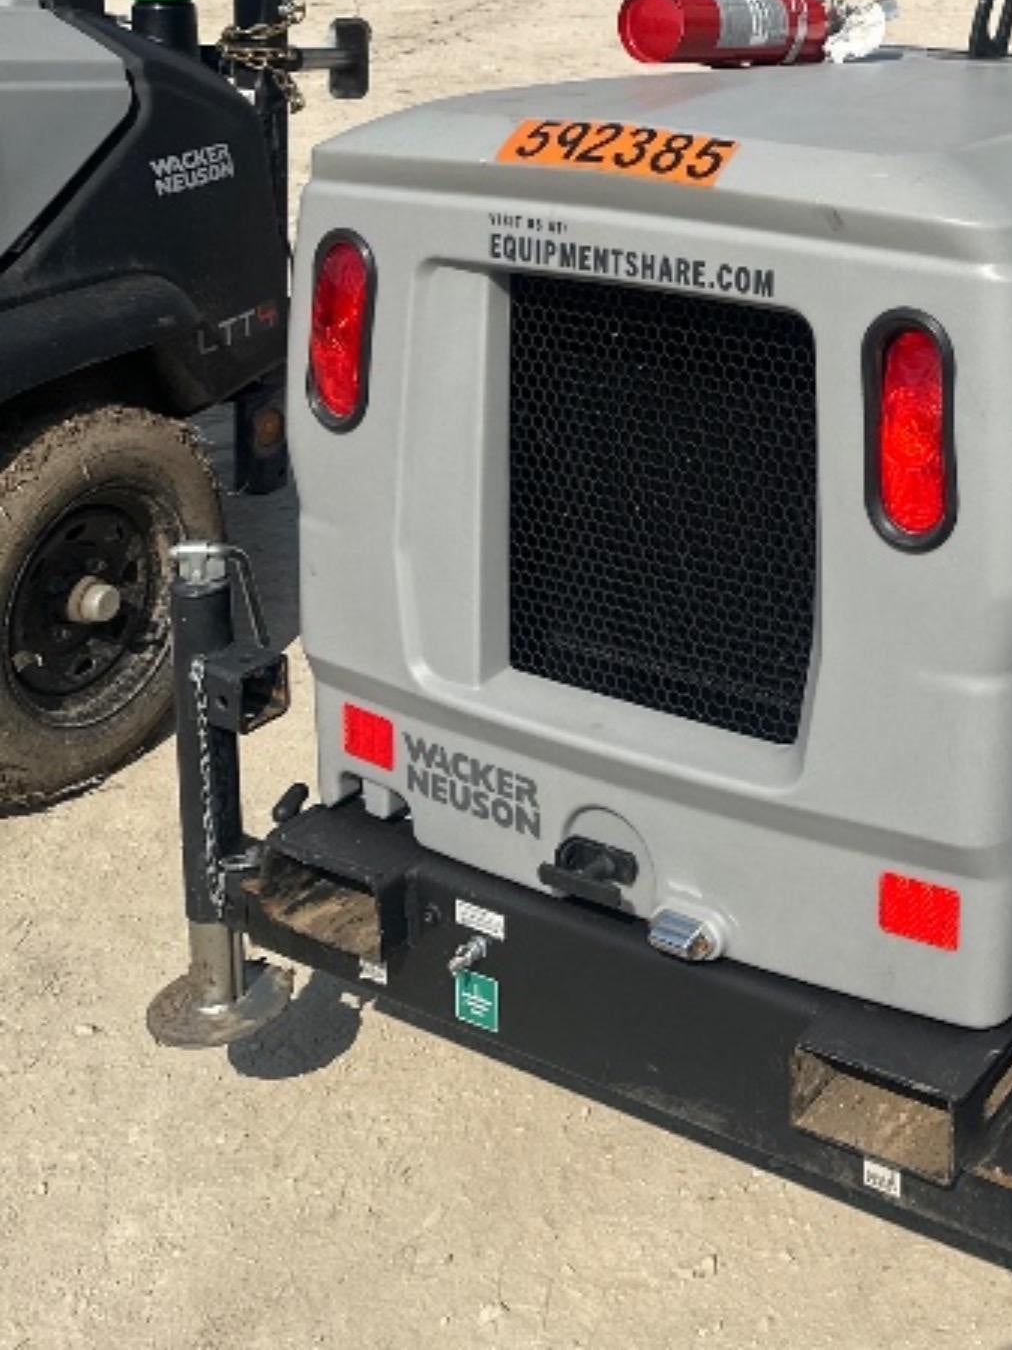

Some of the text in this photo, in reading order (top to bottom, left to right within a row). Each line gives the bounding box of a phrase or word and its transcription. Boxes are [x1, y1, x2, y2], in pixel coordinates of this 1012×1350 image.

[150, 143, 232, 178] WACKER
[154, 161, 235, 197] NEUSON
[514, 119, 737, 181] 592385
[490, 233, 776, 299] EQUIPMENTSHARE.COM
[402, 731, 540, 809] WACKER
[407, 763, 541, 840] NEUSON
